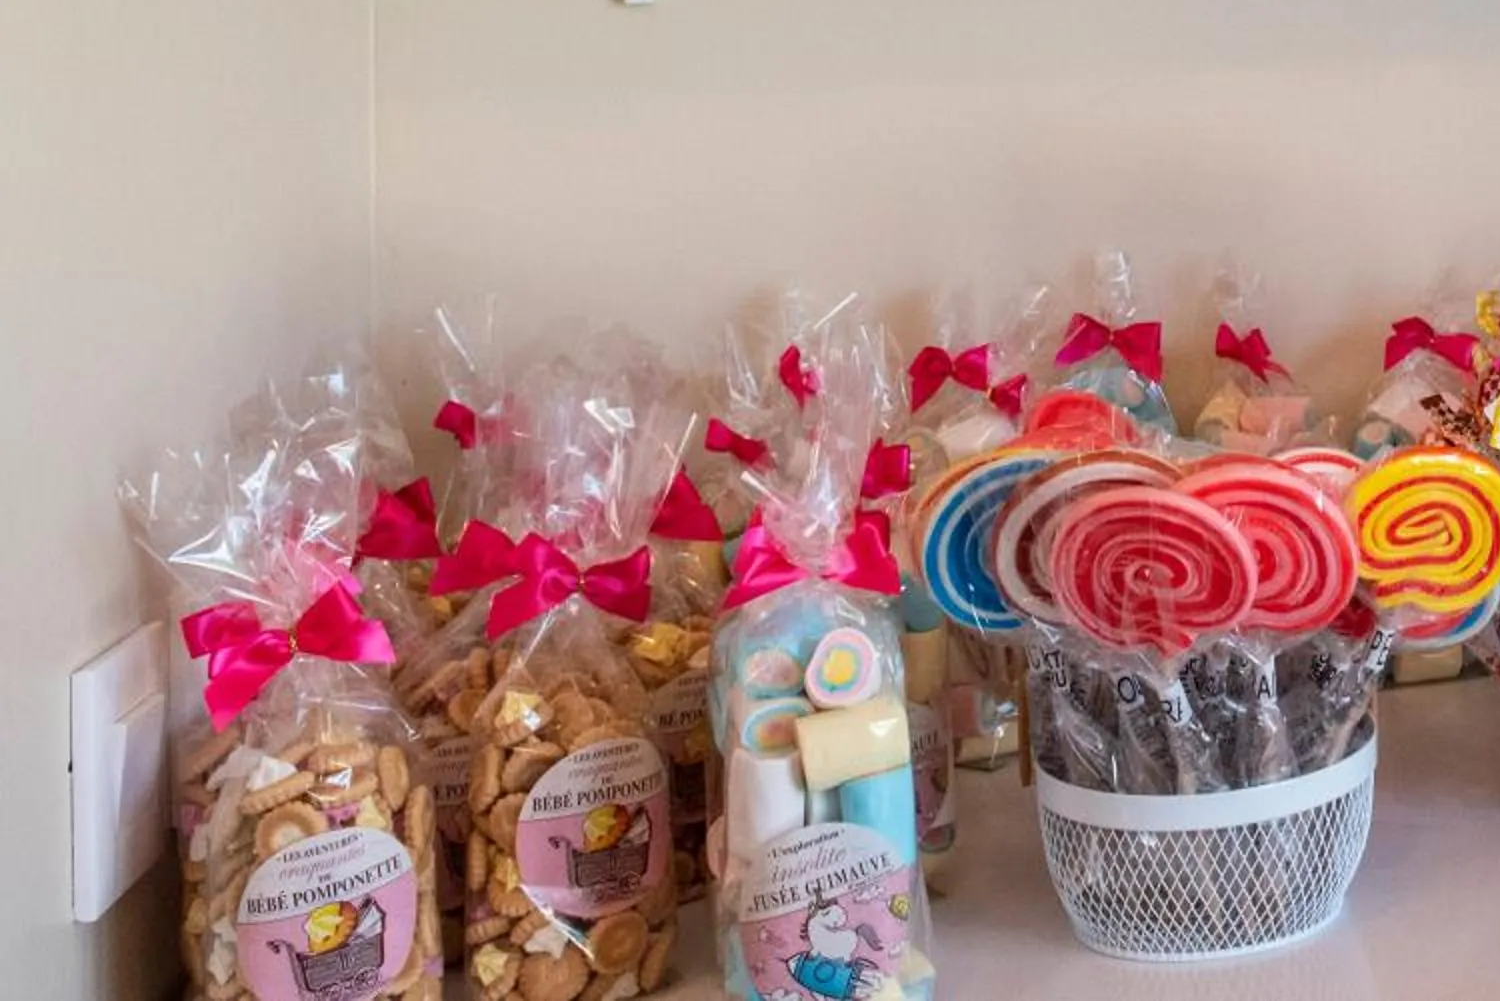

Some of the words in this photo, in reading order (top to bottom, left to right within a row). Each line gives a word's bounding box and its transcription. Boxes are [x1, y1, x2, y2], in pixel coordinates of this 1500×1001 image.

[532, 788, 573, 812] BÉBÉ
[246, 890, 289, 914] BÉBÉ
[292, 853, 403, 908] POMPONETTE
[752, 883, 801, 912] FUSÉE
[805, 851, 892, 896] GUIMAUVE
